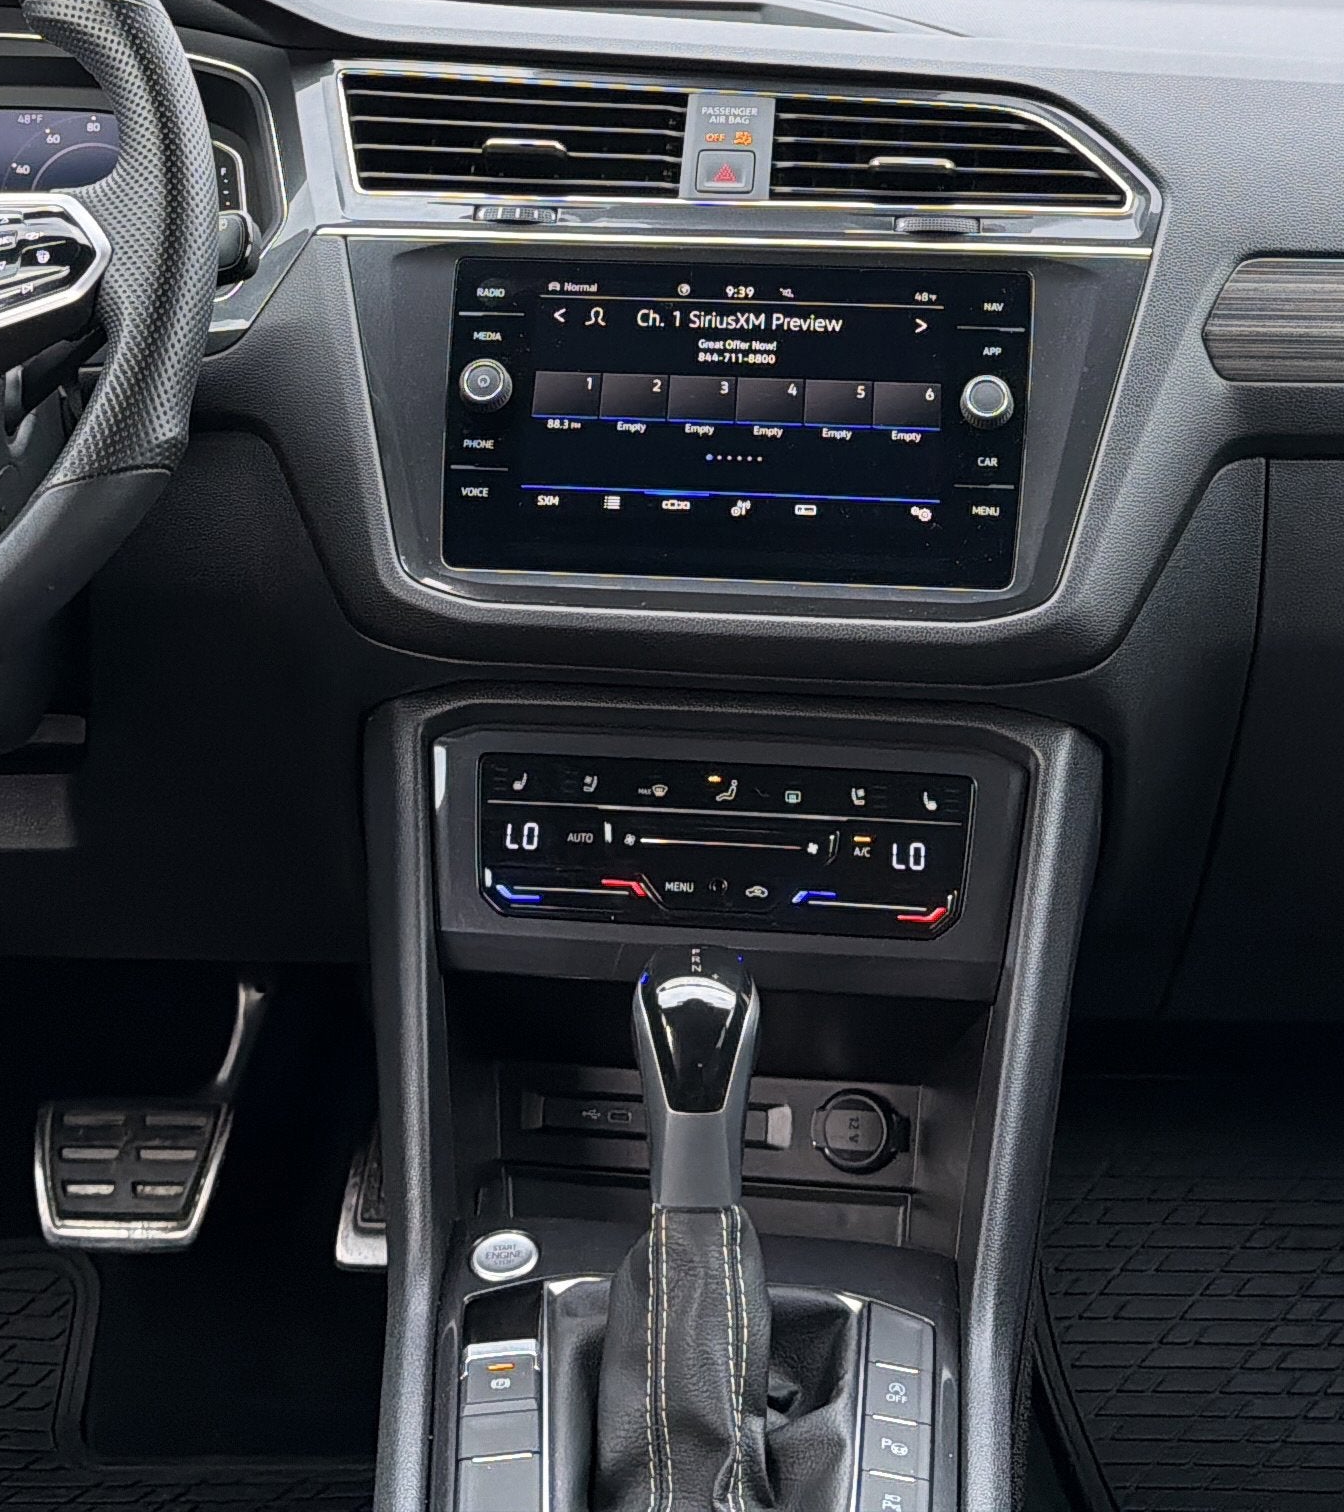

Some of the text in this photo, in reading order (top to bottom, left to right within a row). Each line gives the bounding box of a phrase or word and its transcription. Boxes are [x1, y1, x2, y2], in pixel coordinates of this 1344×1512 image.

[701, 106, 758, 116] PASSENGER
[709, 115, 750, 125] AIR BAG
[86, 123, 101, 132] 80
[46, 134, 61, 144] 60
[705, 132, 726, 142] OFF
[15, 165, 31, 175] 40
[476, 287, 506, 298] RADIO
[563, 282, 598, 293] Normal
[725, 285, 755, 298] 9:39
[983, 302, 1005, 312] NAV
[636, 309, 843, 332] Ch. 1 SiriusXM Preview
[473, 331, 503, 341] MEDIA
[698, 338, 777, 351] Great Offer Now!
[982, 346, 1003, 356] APP
[697, 352, 776, 364] 844-711-8800
[586, 377, 593, 390] 1
[652, 379, 662, 392] 2
[719, 381, 729, 394] 3
[787, 383, 798, 396] 4
[856, 385, 866, 398] 5
[925, 388, 935, 401] 6
[546, 419, 569, 430] 88.3
[616, 421, 647, 434] Empty
[684, 423, 715, 436] Empty
[753, 425, 783, 438] Empty
[822, 428, 852, 440] Empty
[891, 430, 922, 443] Empty
[463, 439, 495, 450] PHONE
[977, 457, 998, 467] CAR
[460, 486, 489, 497] VOICE
[536, 495, 560, 506] SXM
[971, 505, 1000, 517] MENU
[506, 822, 539, 851] LO
[567, 832, 594, 844] AUTO
[853, 846, 871, 858] A/C
[892, 842, 925, 871] LO
[665, 881, 694, 893] MENU
[691, 955, 701, 963] R
[691, 964, 702, 973] N
[492, 1243, 517, 1251] START
[485, 1250, 521, 1260] ENGINE
[885, 1393, 908, 1403] OFF
